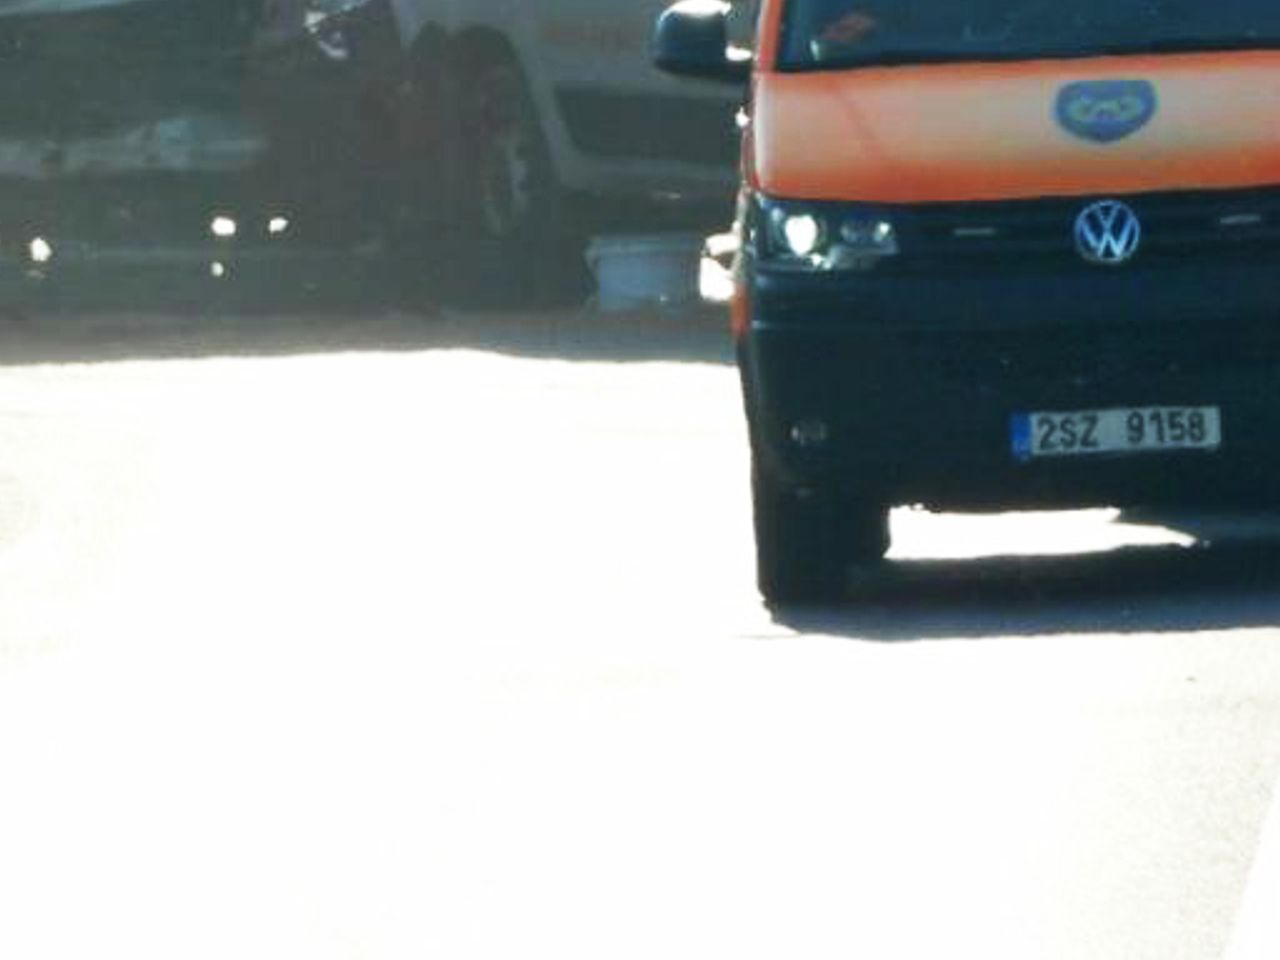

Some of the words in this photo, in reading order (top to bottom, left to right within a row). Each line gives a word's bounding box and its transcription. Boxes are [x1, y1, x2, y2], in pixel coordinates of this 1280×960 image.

[1075, 199, 1140, 263] VW
[1036, 413, 1099, 449] 2SZ
[1125, 409, 1206, 444] 9158
